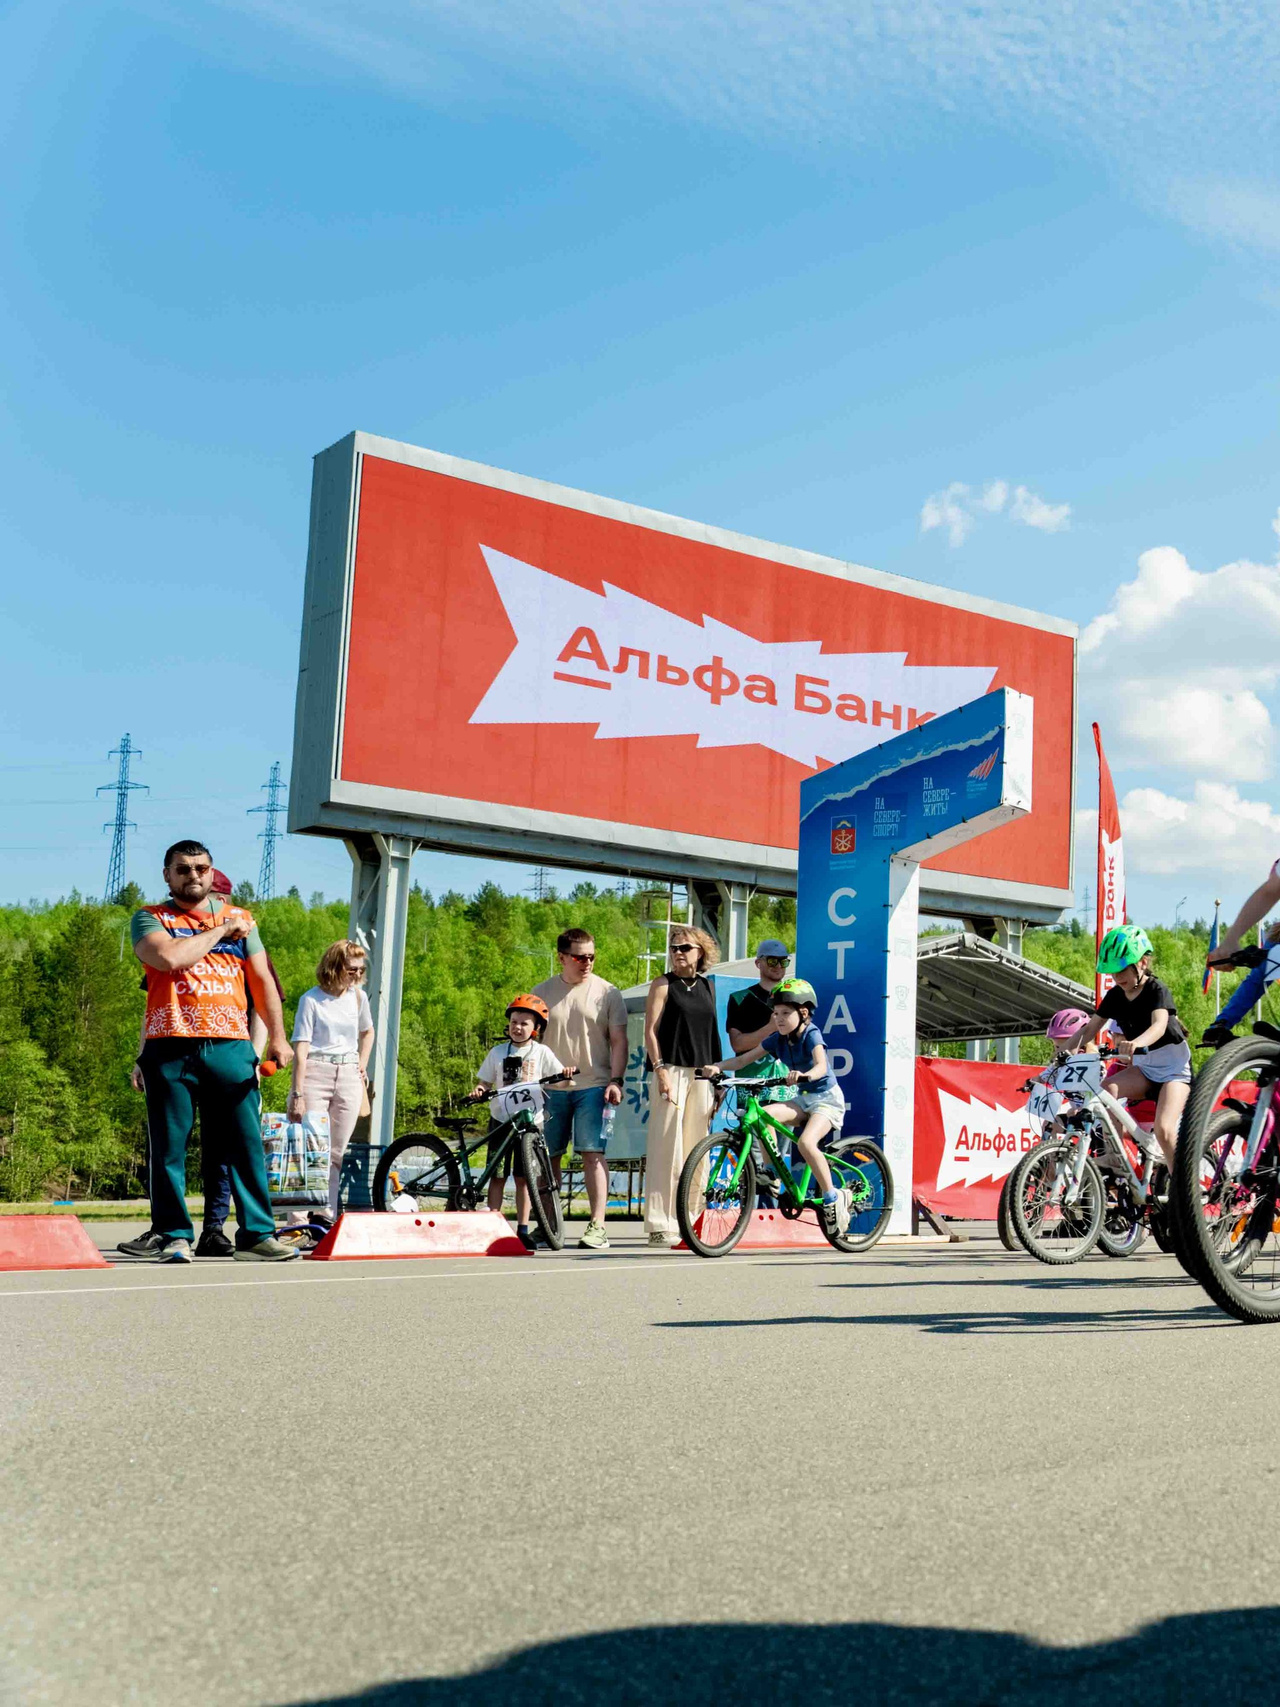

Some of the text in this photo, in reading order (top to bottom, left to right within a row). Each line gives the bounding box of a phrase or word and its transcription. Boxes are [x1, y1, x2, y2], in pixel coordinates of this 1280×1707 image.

[553, 625, 778, 706] Альфа
[923, 777, 934, 790] НА
[875, 797, 886, 810] НА
[923, 801, 949, 817] ЖИТЬ!
[873, 823, 899, 837] СПОРТ!
[175, 980, 234, 997] СУДЬЯ
[1062, 1066, 1088, 1083] 27
[509, 1089, 532, 1104] 12
[1034, 1095, 1049, 1112] 11
[955, 1124, 1041, 1159] Альфа Ба
